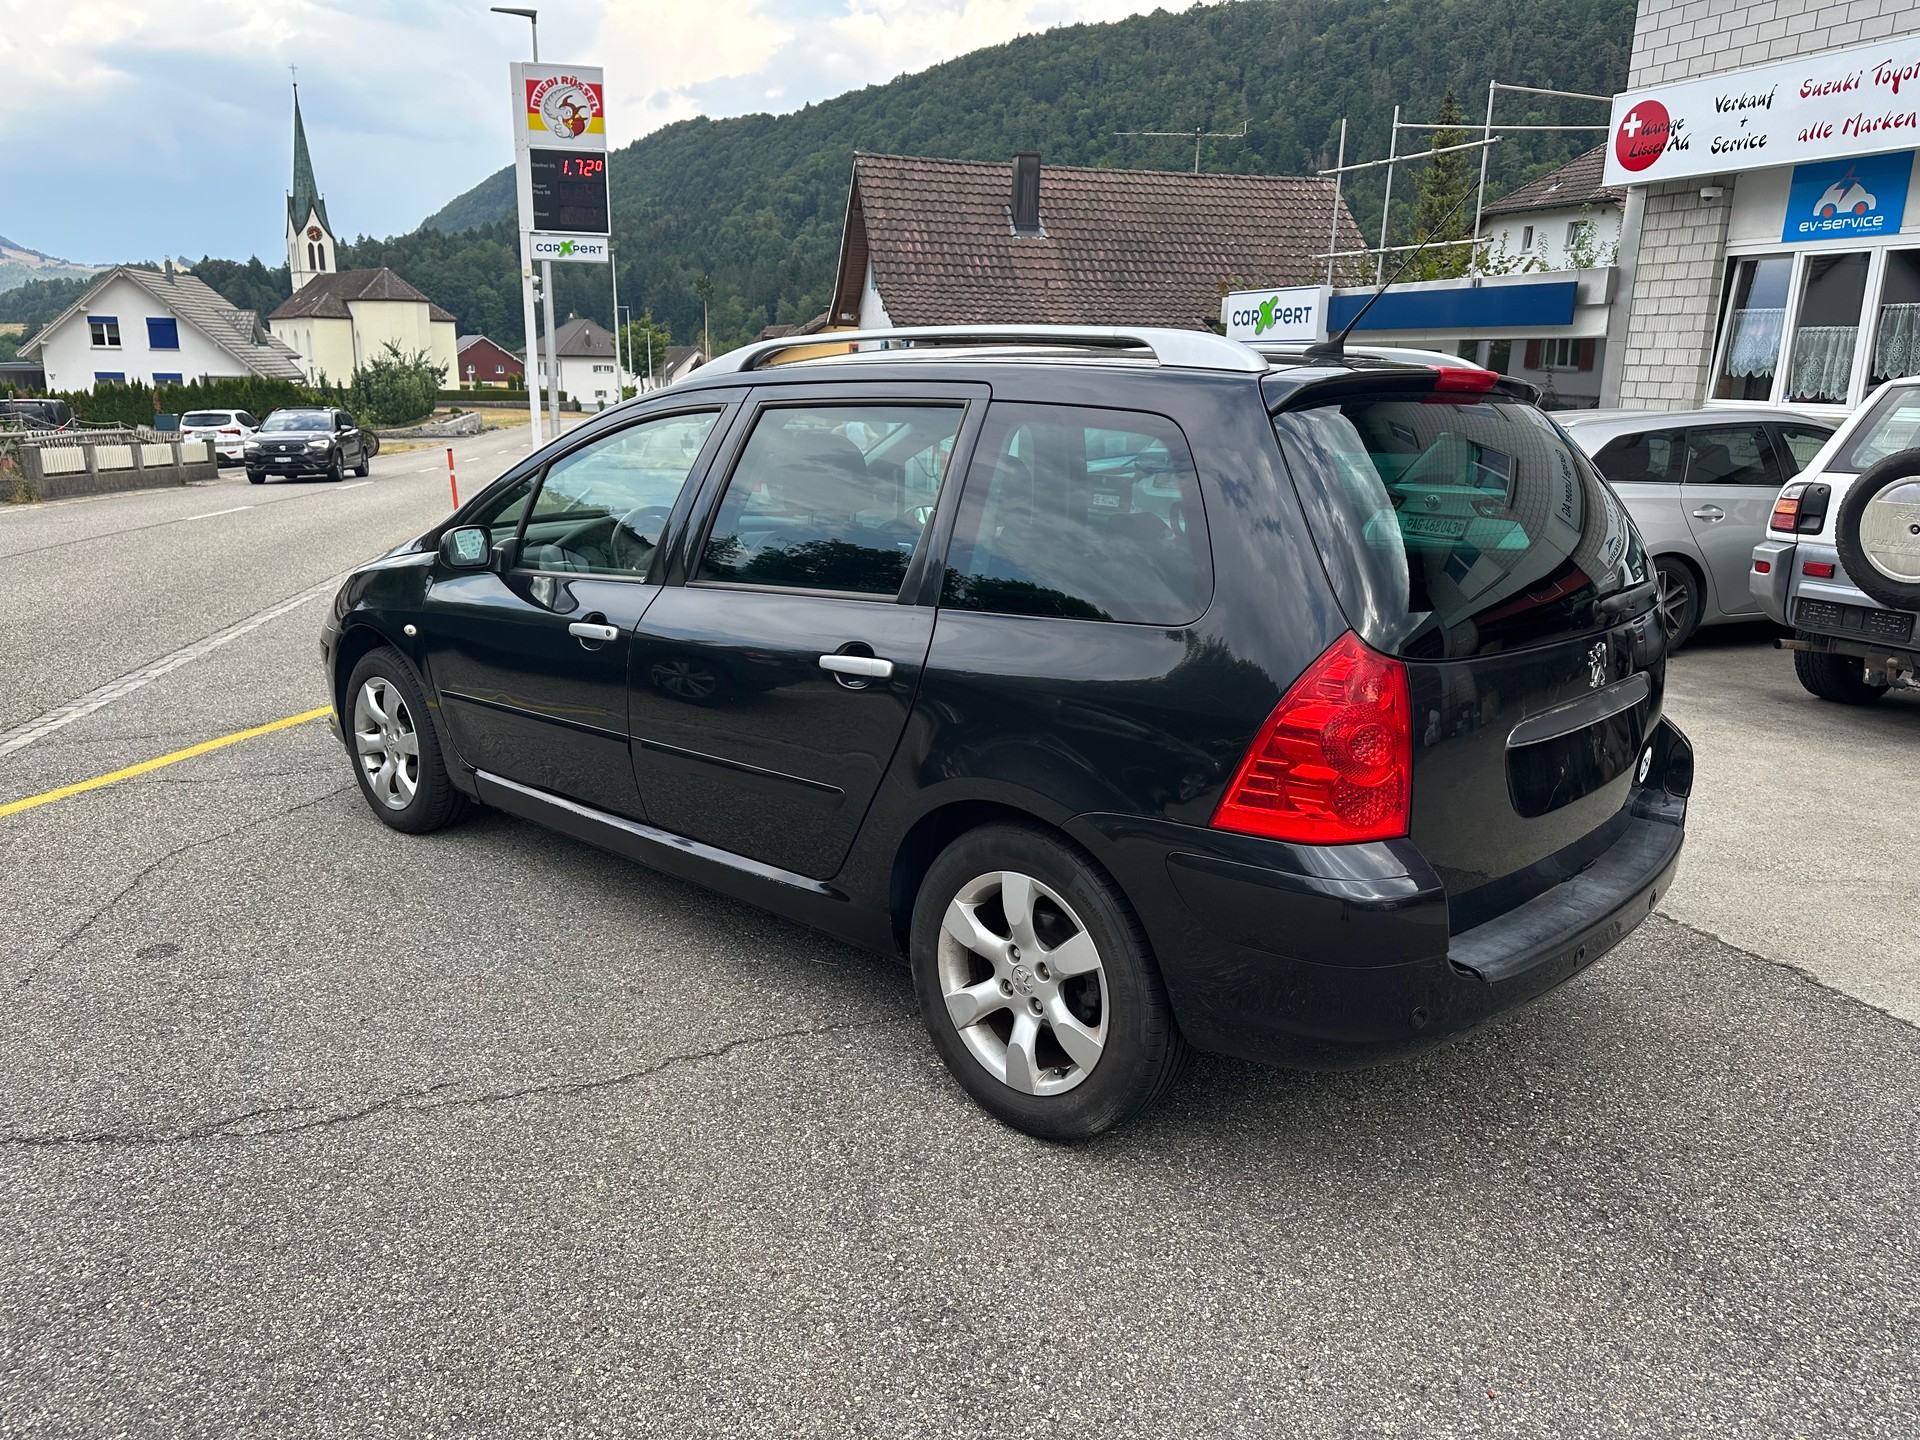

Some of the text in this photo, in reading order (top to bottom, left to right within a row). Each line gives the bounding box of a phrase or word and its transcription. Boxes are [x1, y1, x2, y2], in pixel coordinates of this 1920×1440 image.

[530, 75, 597, 113] RUEDI RÜSSEL
[1715, 83, 1779, 114] Verkauf
[1799, 70, 1864, 99] Suzuki
[1640, 116, 1685, 138] Garage
[1797, 110, 1917, 143] alle Marken
[1710, 132, 1768, 155] Service
[1798, 215, 1884, 232] ev-service
